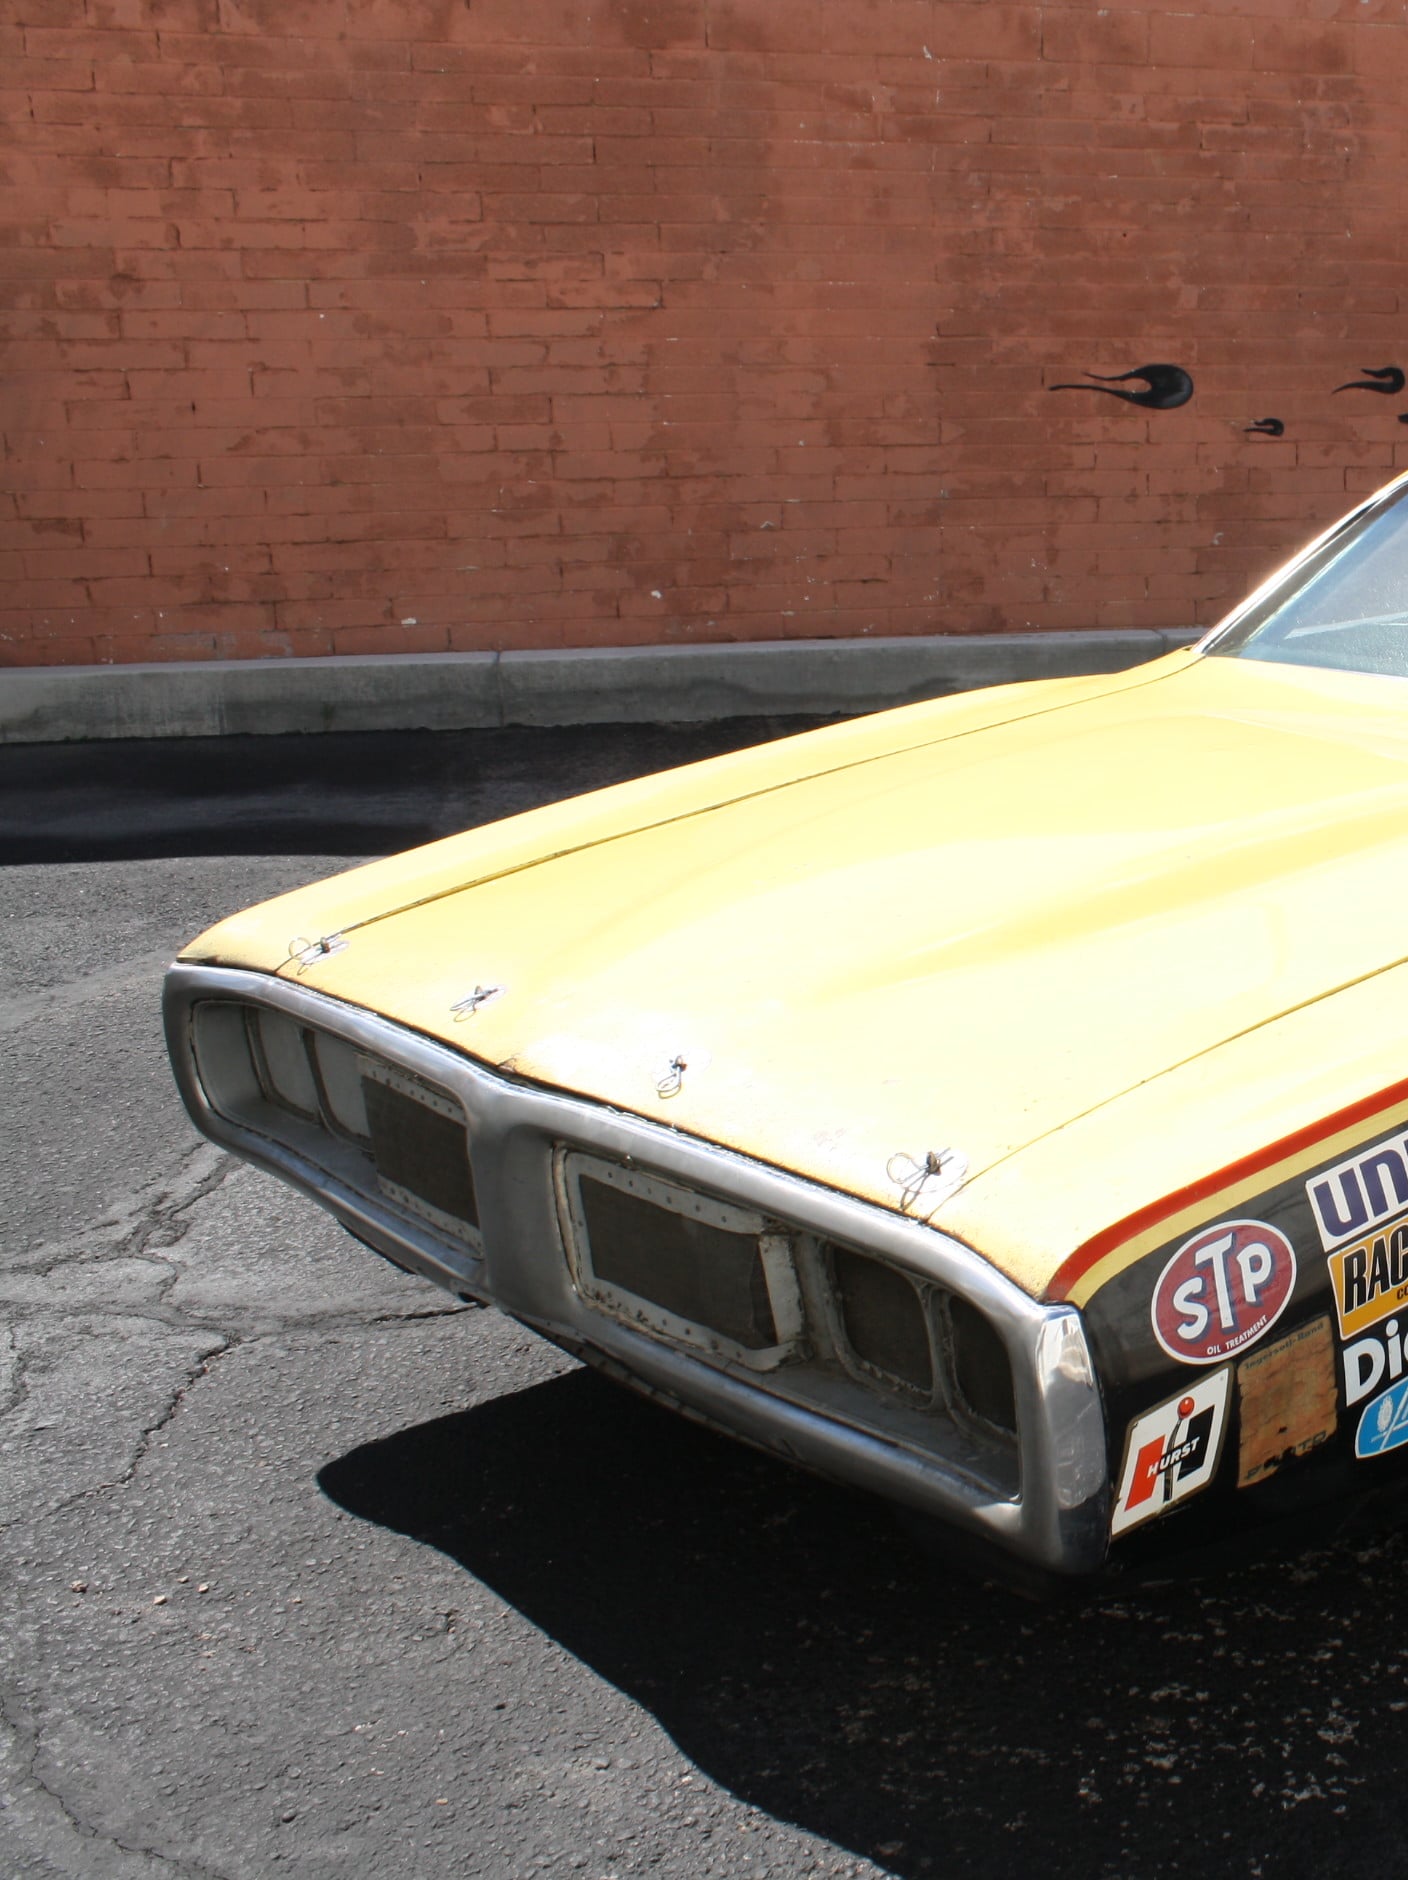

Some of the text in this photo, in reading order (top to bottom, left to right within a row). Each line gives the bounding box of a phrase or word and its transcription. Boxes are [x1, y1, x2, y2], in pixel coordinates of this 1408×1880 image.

[1172, 1231, 1273, 1340] STP
[1206, 1314, 1268, 1356] OIL TREATMENT
[1146, 1434, 1202, 1479] HURST
